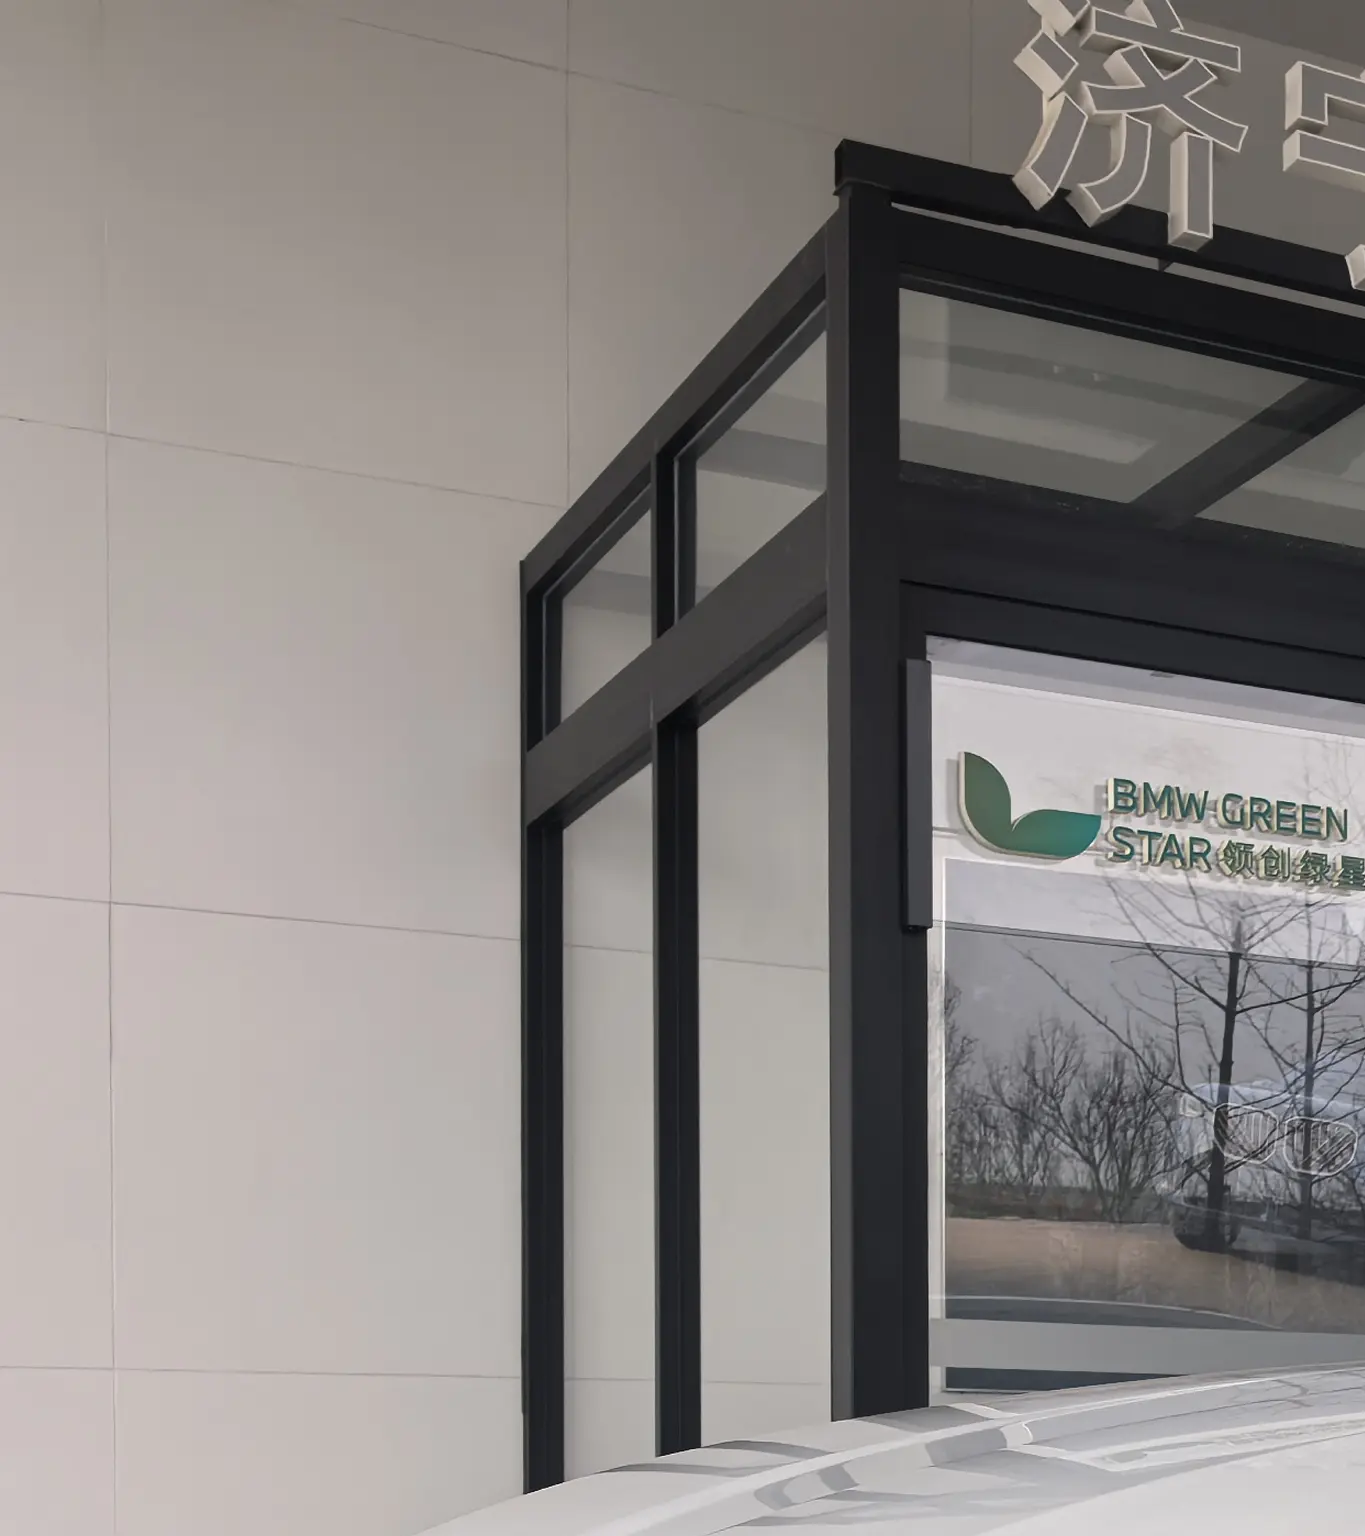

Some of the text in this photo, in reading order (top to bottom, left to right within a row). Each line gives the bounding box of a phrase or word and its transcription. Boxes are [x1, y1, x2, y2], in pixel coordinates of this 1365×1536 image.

[1107, 776, 1349, 843] BMW GREEN
[1107, 825, 1212, 873] STAR
